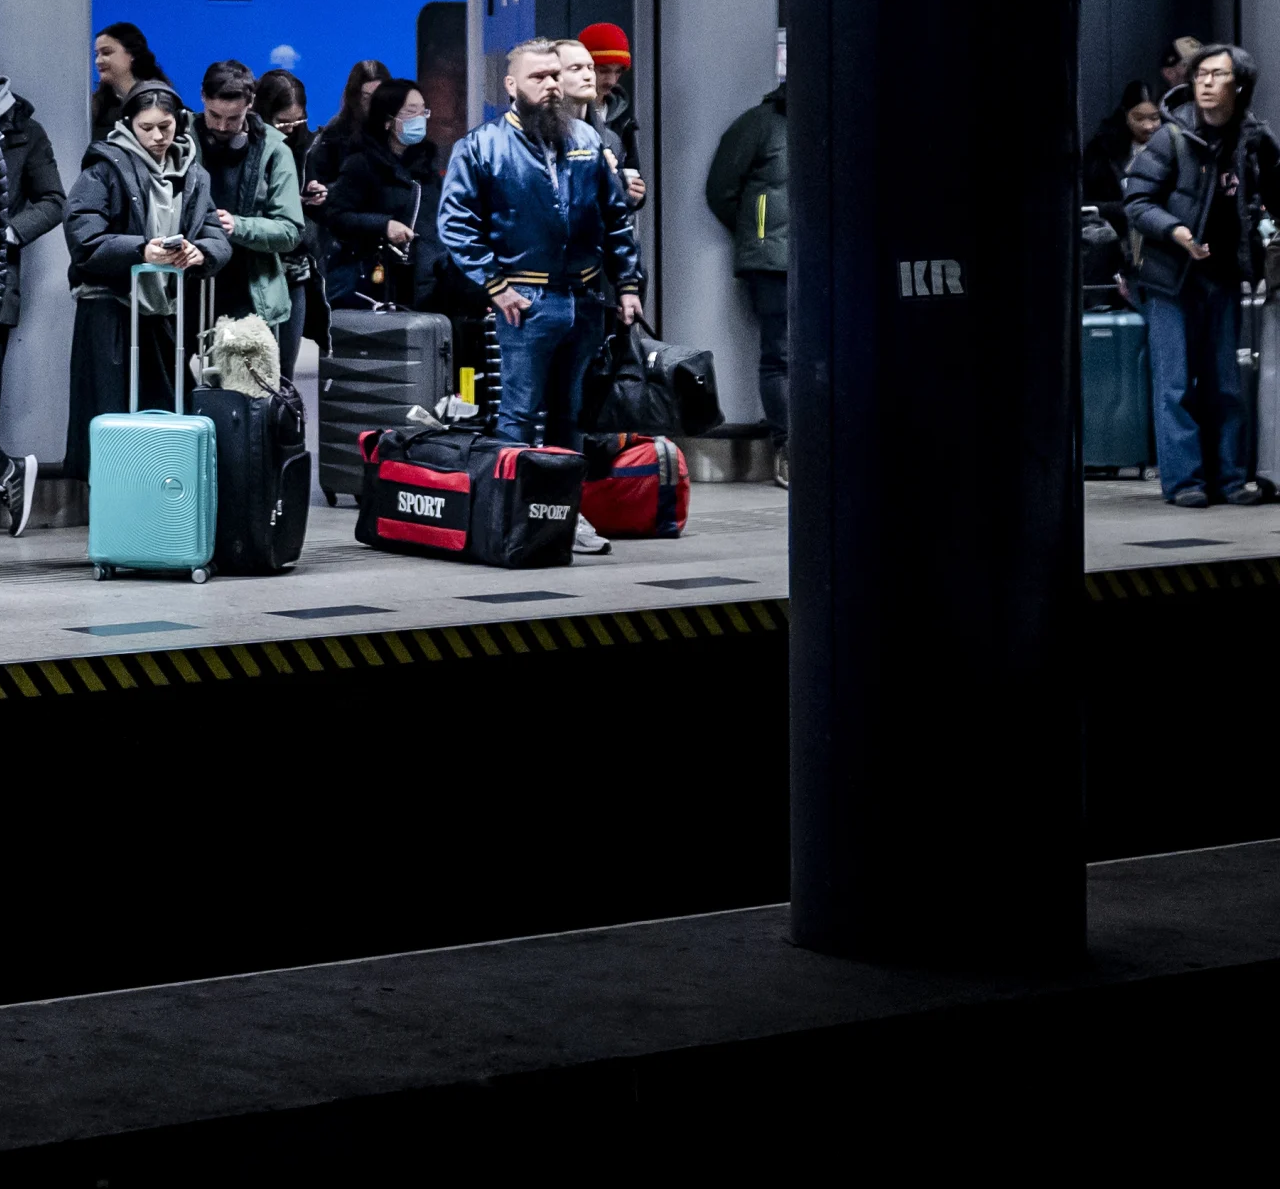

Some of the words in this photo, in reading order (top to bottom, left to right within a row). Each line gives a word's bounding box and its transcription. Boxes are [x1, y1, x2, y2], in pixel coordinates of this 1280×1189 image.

[900, 260, 964, 297] KR
[398, 491, 445, 519] SPORT
[529, 503, 571, 520] SPORT
